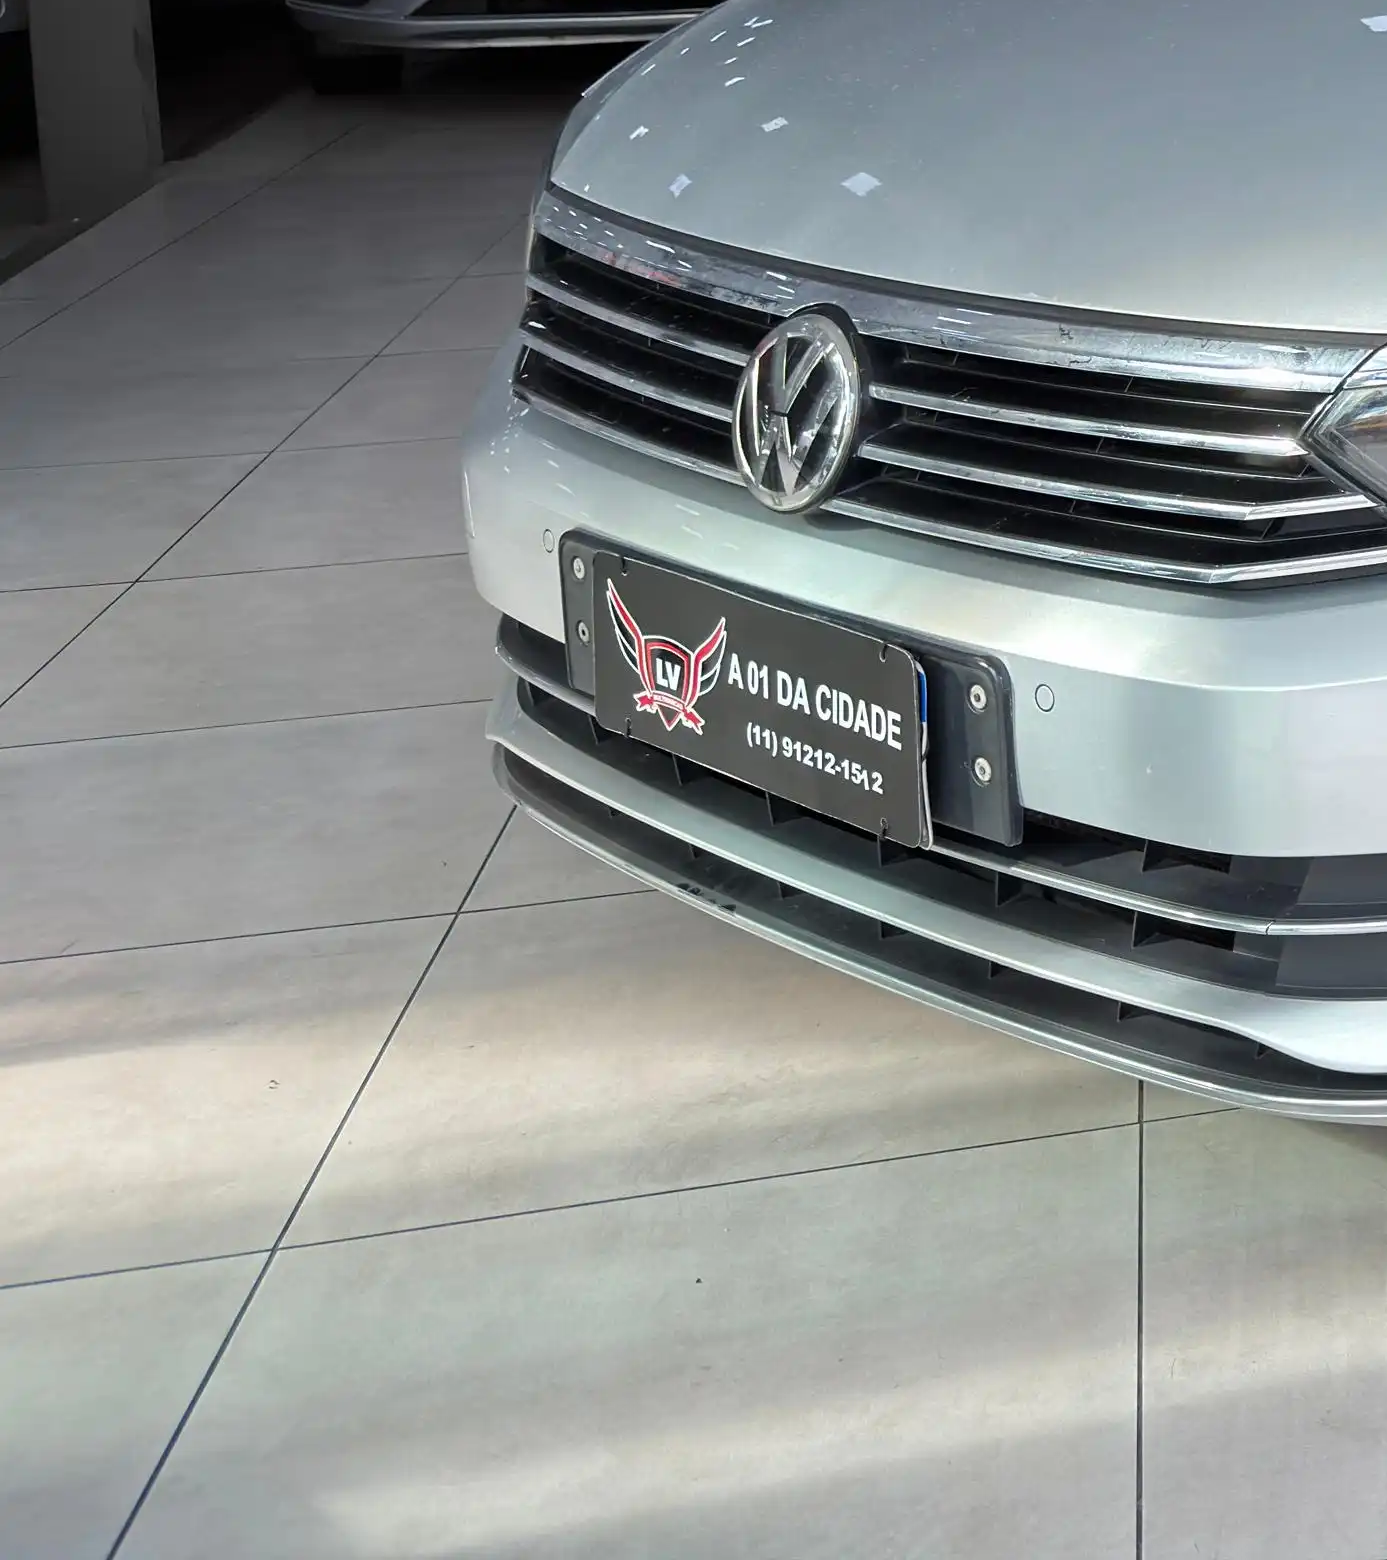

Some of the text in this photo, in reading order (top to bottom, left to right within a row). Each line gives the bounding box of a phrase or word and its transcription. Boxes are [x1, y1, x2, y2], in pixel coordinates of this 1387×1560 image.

[655, 657, 681, 690] LV
[728, 653, 902, 751] A 01 DA CIDADE
[746, 721, 884, 795] (11) 91212-1512
